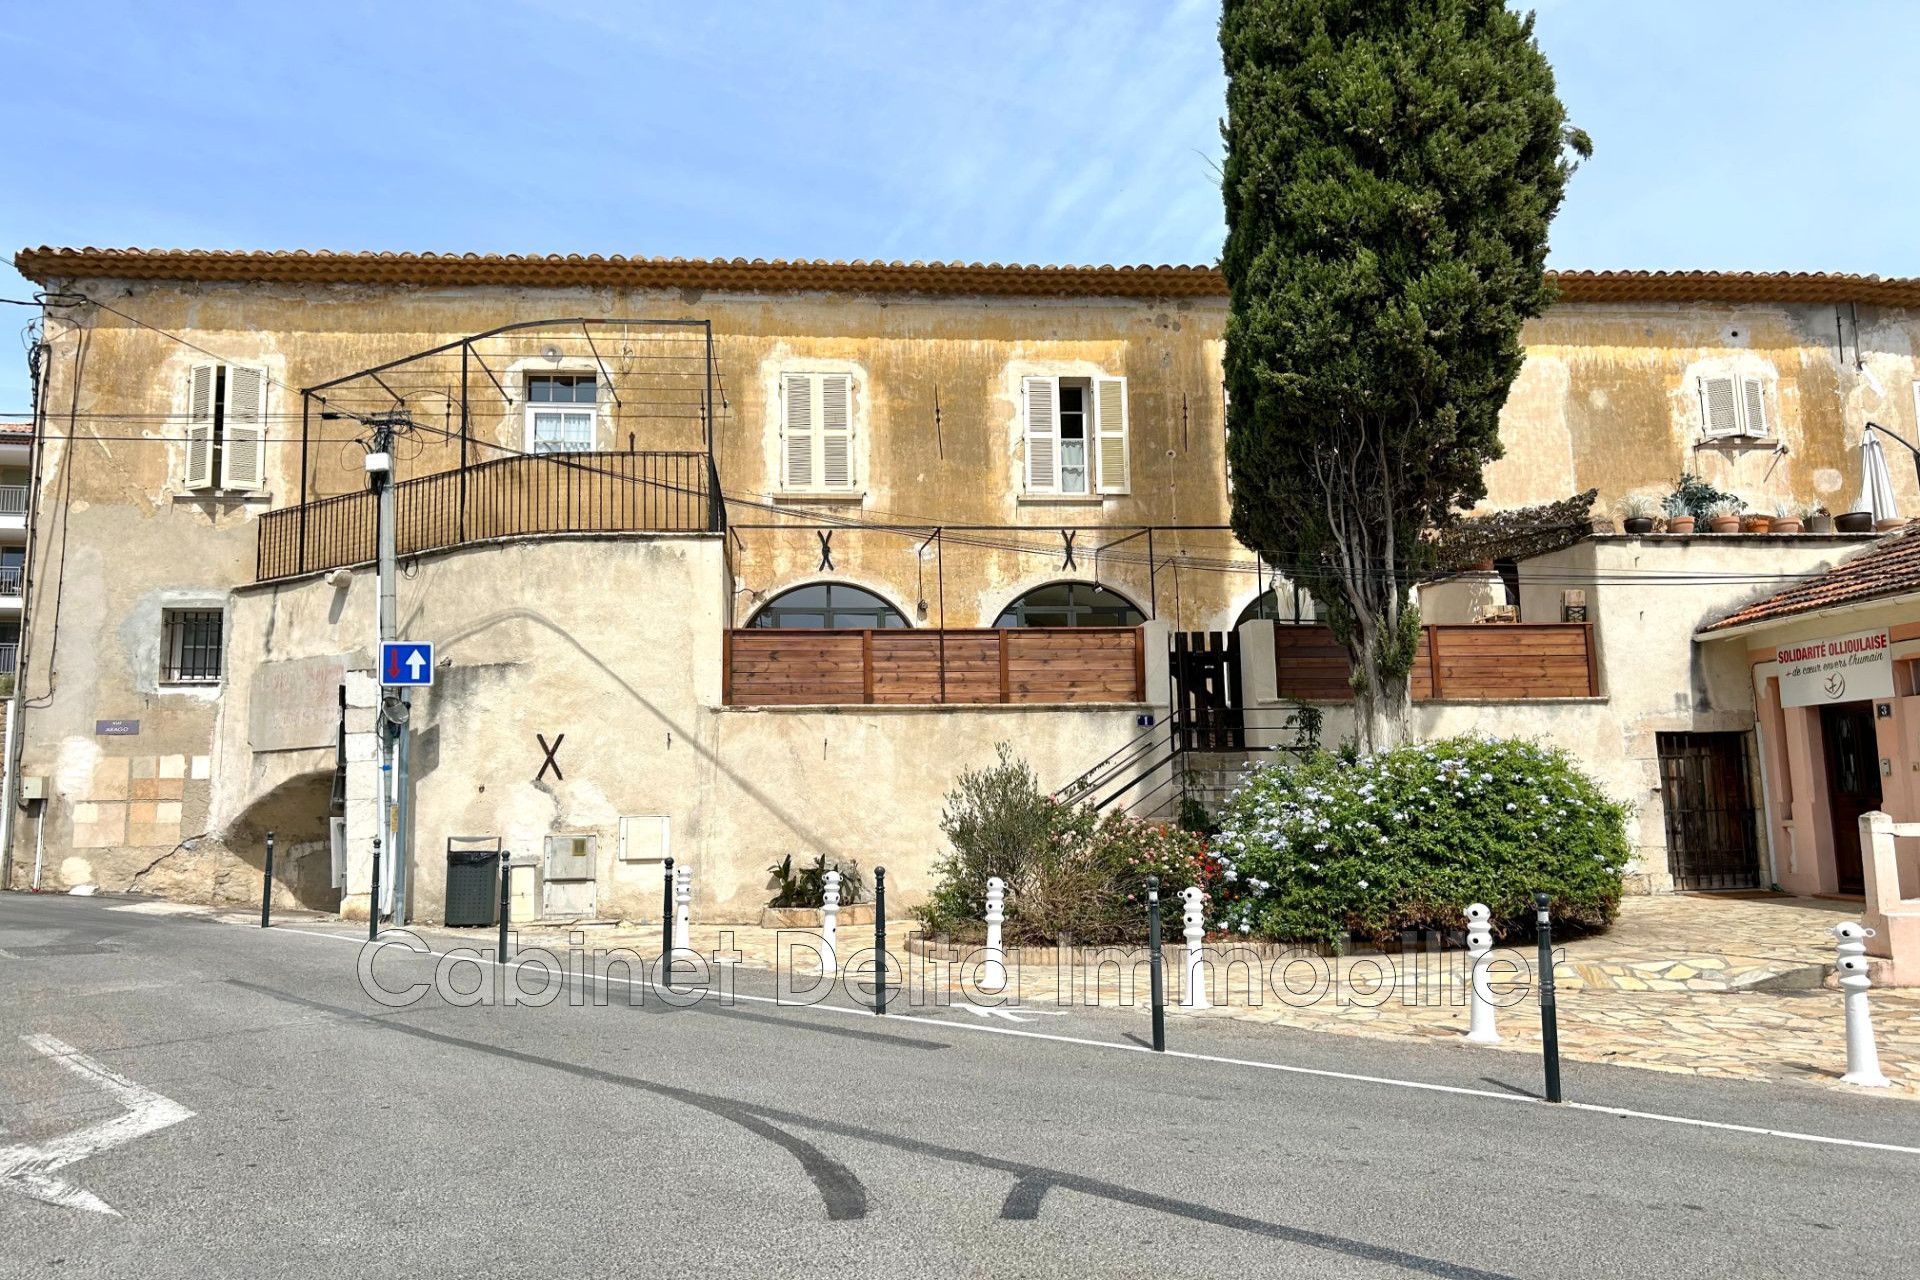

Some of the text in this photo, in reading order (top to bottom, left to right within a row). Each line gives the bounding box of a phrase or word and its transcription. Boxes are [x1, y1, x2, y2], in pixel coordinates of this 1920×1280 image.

[1778, 634, 1887, 664] SOLIDARITÉ OLLIOULAISE
[1880, 705, 1888, 716] 3
